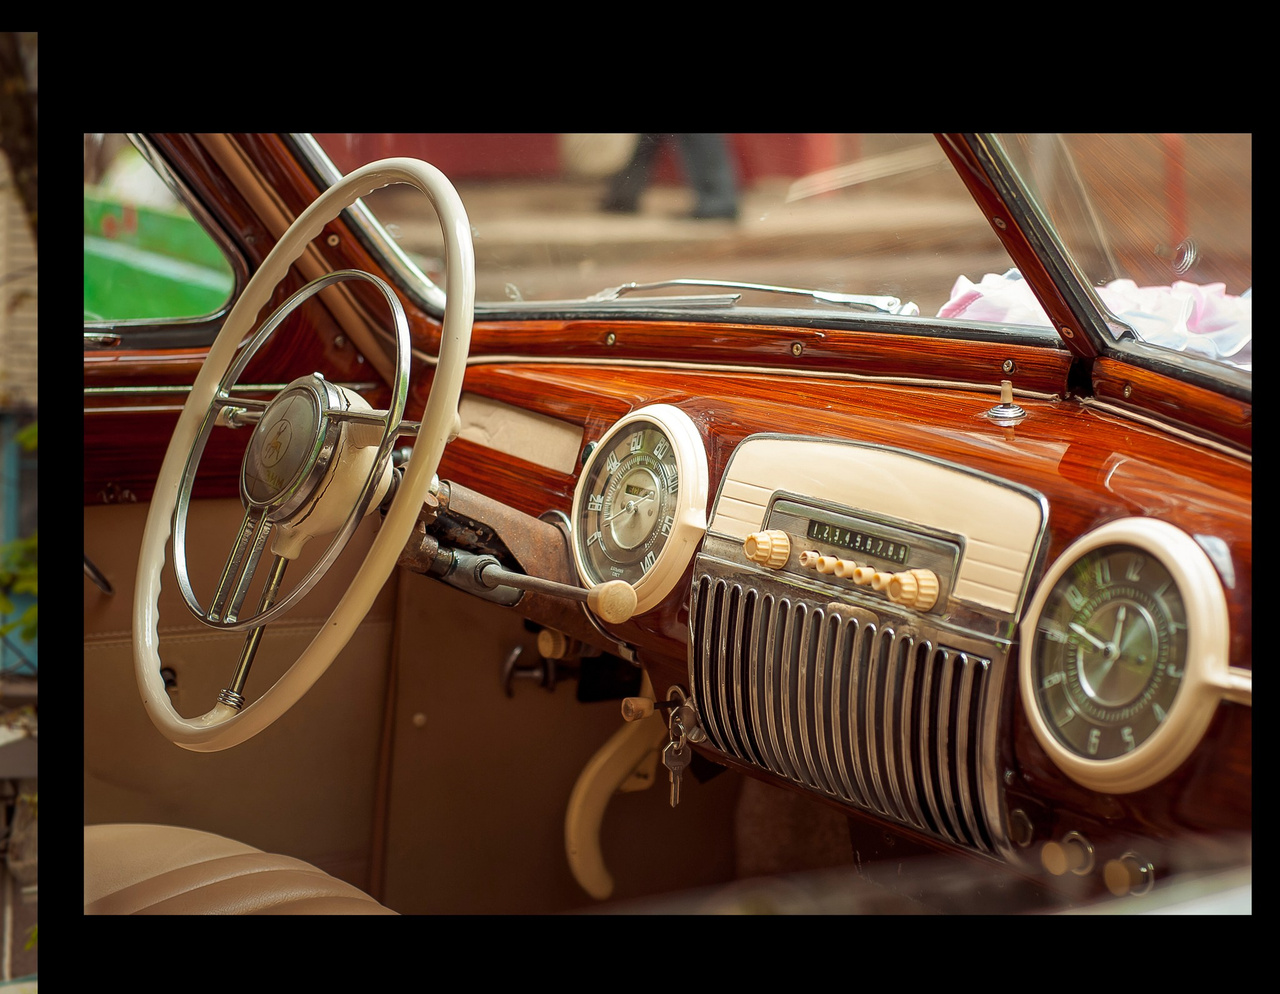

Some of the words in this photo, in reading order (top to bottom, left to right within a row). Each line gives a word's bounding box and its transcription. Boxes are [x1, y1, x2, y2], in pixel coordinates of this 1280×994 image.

[630, 431, 643, 451] 60
[653, 437, 670, 460] 80
[606, 450, 620, 473] 40
[588, 494, 603, 511] 20
[661, 515, 674, 537] 120
[640, 550, 657, 576] 140
[1125, 557, 1145, 582] 12
[1088, 728, 1101, 756] 6
[1121, 726, 1136, 752] 5
